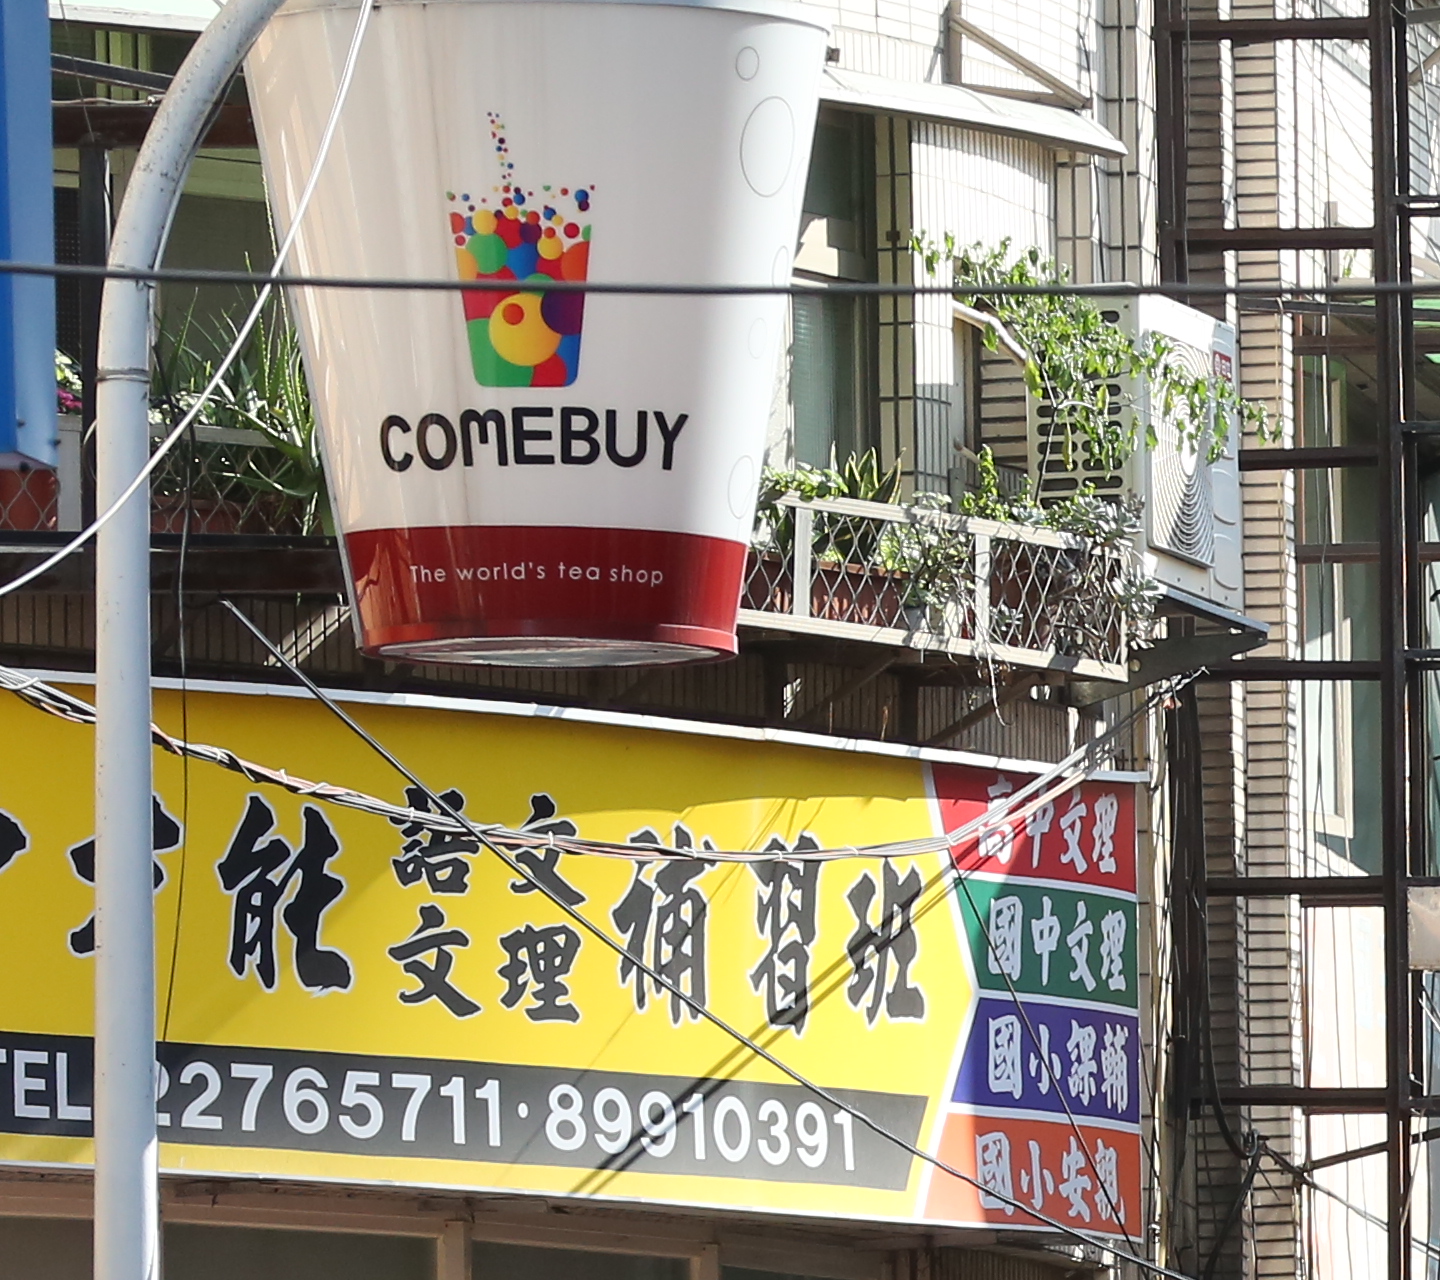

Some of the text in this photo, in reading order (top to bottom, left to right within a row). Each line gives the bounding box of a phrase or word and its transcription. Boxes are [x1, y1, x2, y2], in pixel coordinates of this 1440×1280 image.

[379, 405, 689, 472] COMEBUY
[409, 561, 665, 589] The world's tea shop
[391, 903, 583, 1023] 文理
[613, 822, 924, 1033] 補習班
[988, 895, 1127, 992] 國中文理
[987, 1014, 1128, 1113] 國小課輔
[976, 1132, 1126, 1226] 國小安親
